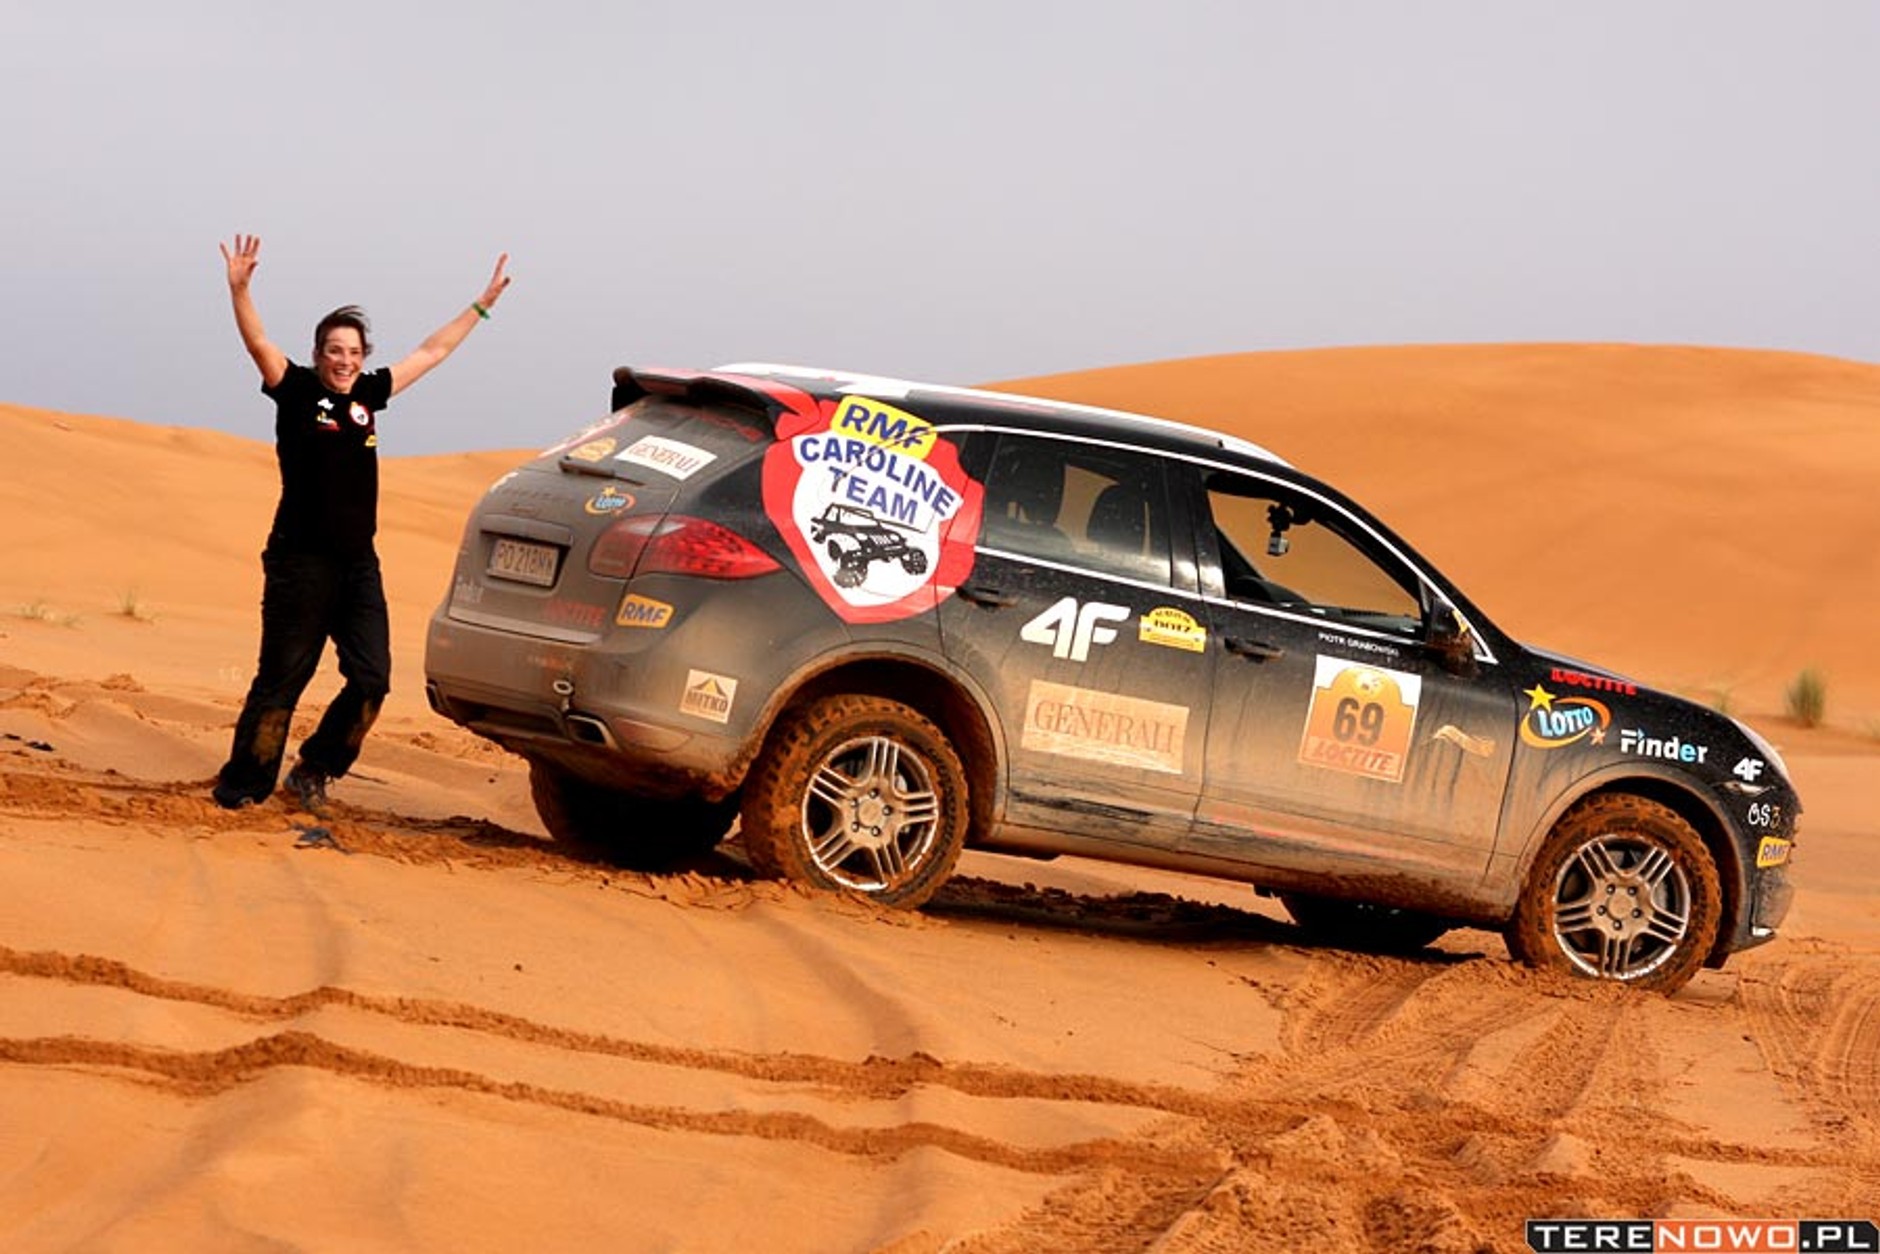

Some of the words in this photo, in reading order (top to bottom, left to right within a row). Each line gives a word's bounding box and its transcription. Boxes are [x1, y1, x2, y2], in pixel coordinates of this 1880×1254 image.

[841, 403, 933, 449] RMF
[800, 437, 955, 517] CAROLINE
[828, 466, 919, 525] TEAM
[621, 601, 669, 624] RMF
[1020, 597, 1131, 662] 4F
[1034, 699, 1177, 753] GENERALI
[1332, 696, 1385, 748] 69
[1537, 705, 1594, 738] LOTTO
[1315, 738, 1395, 773] LOCTITE
[1620, 728, 1709, 765] Finder
[1732, 757, 1765, 782] 4F
